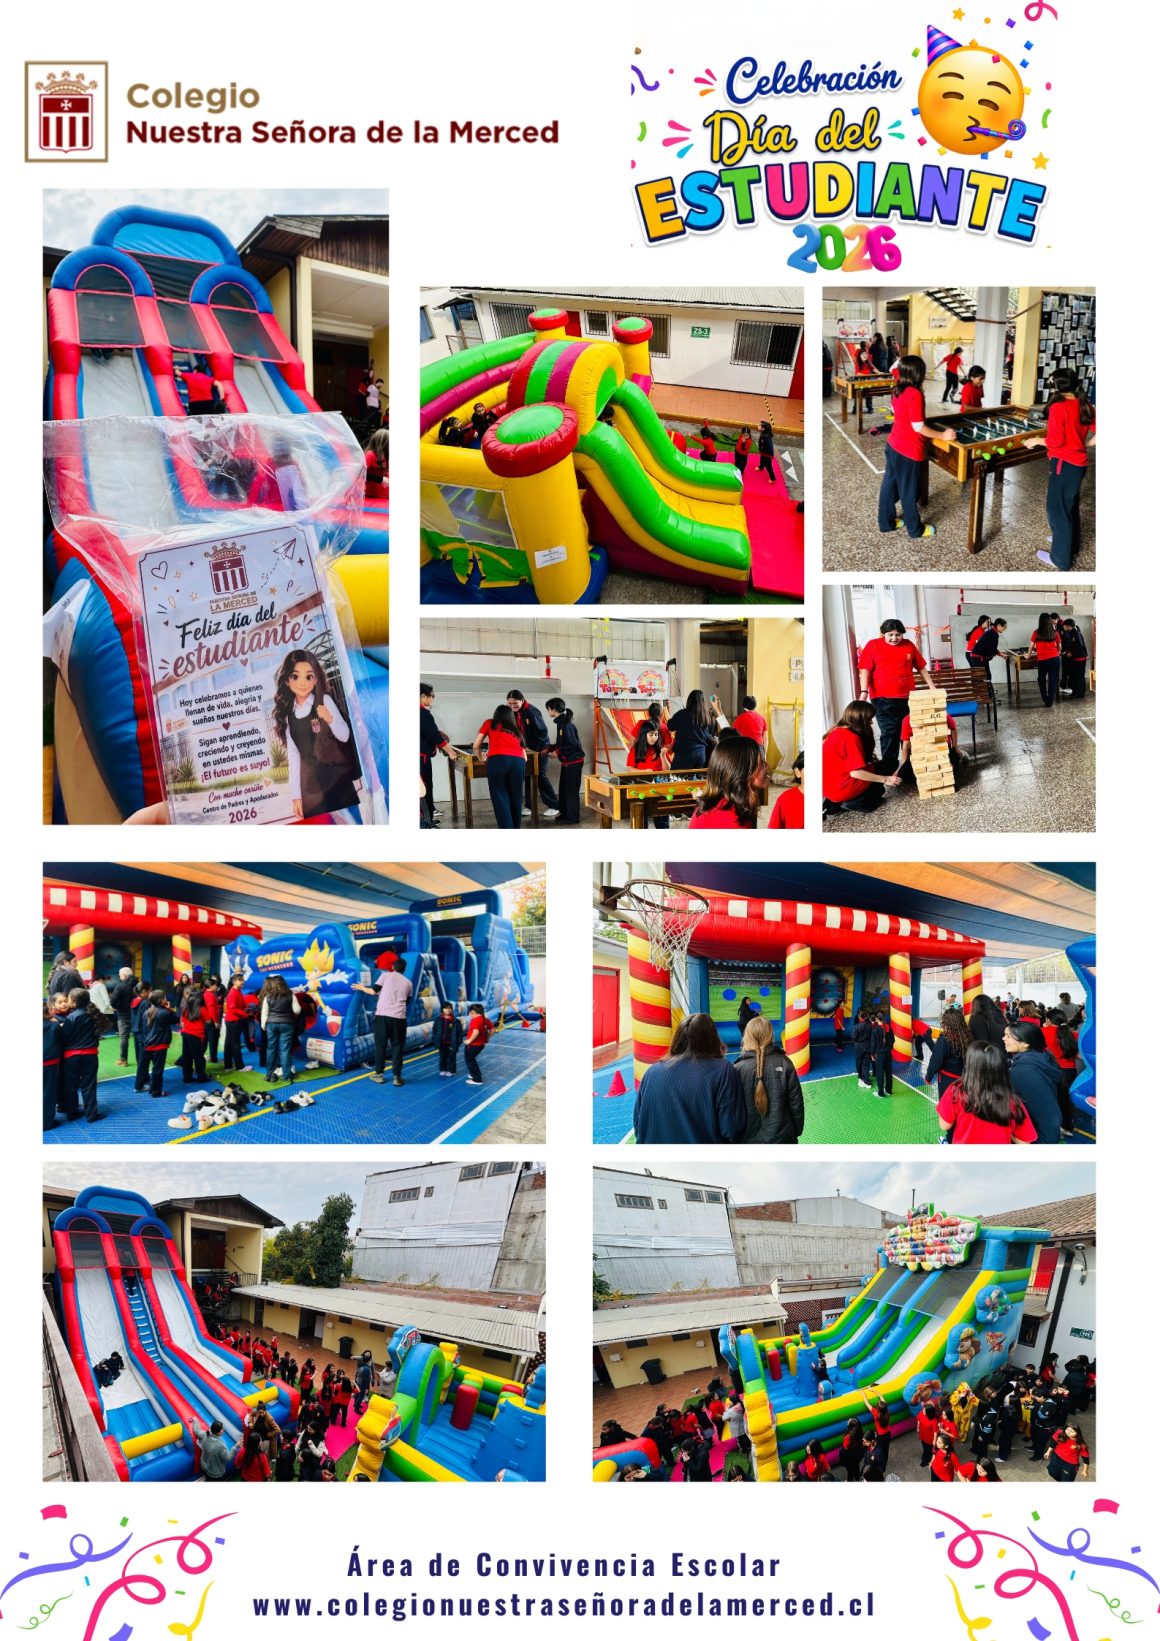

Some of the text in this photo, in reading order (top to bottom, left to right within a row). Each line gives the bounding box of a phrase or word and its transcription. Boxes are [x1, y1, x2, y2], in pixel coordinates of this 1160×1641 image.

[223, 595, 258, 610] MERCED
[175, 601, 278, 649] Feliz día del
[173, 614, 304, 678] estudiante
[179, 698, 193, 708] Hoy
[194, 690, 231, 704] celebramos
[238, 684, 263, 696] quienes
[185, 694, 262, 716] llenan de vida, alegría y
[192, 715, 215, 726] sueños
[216, 709, 244, 721] nuestros
[245, 705, 261, 714] días.
[197, 736, 266, 758] creciendo y creyendo
[198, 727, 261, 748] Sigan aprendiendo,
[202, 748, 266, 768] en ustedes mismas.
[200, 757, 271, 783] ¡El futuro es suyo!
[208, 791, 222, 804] Con
[228, 806, 257, 824] 2026
[256, 949, 294, 968] SONIC
